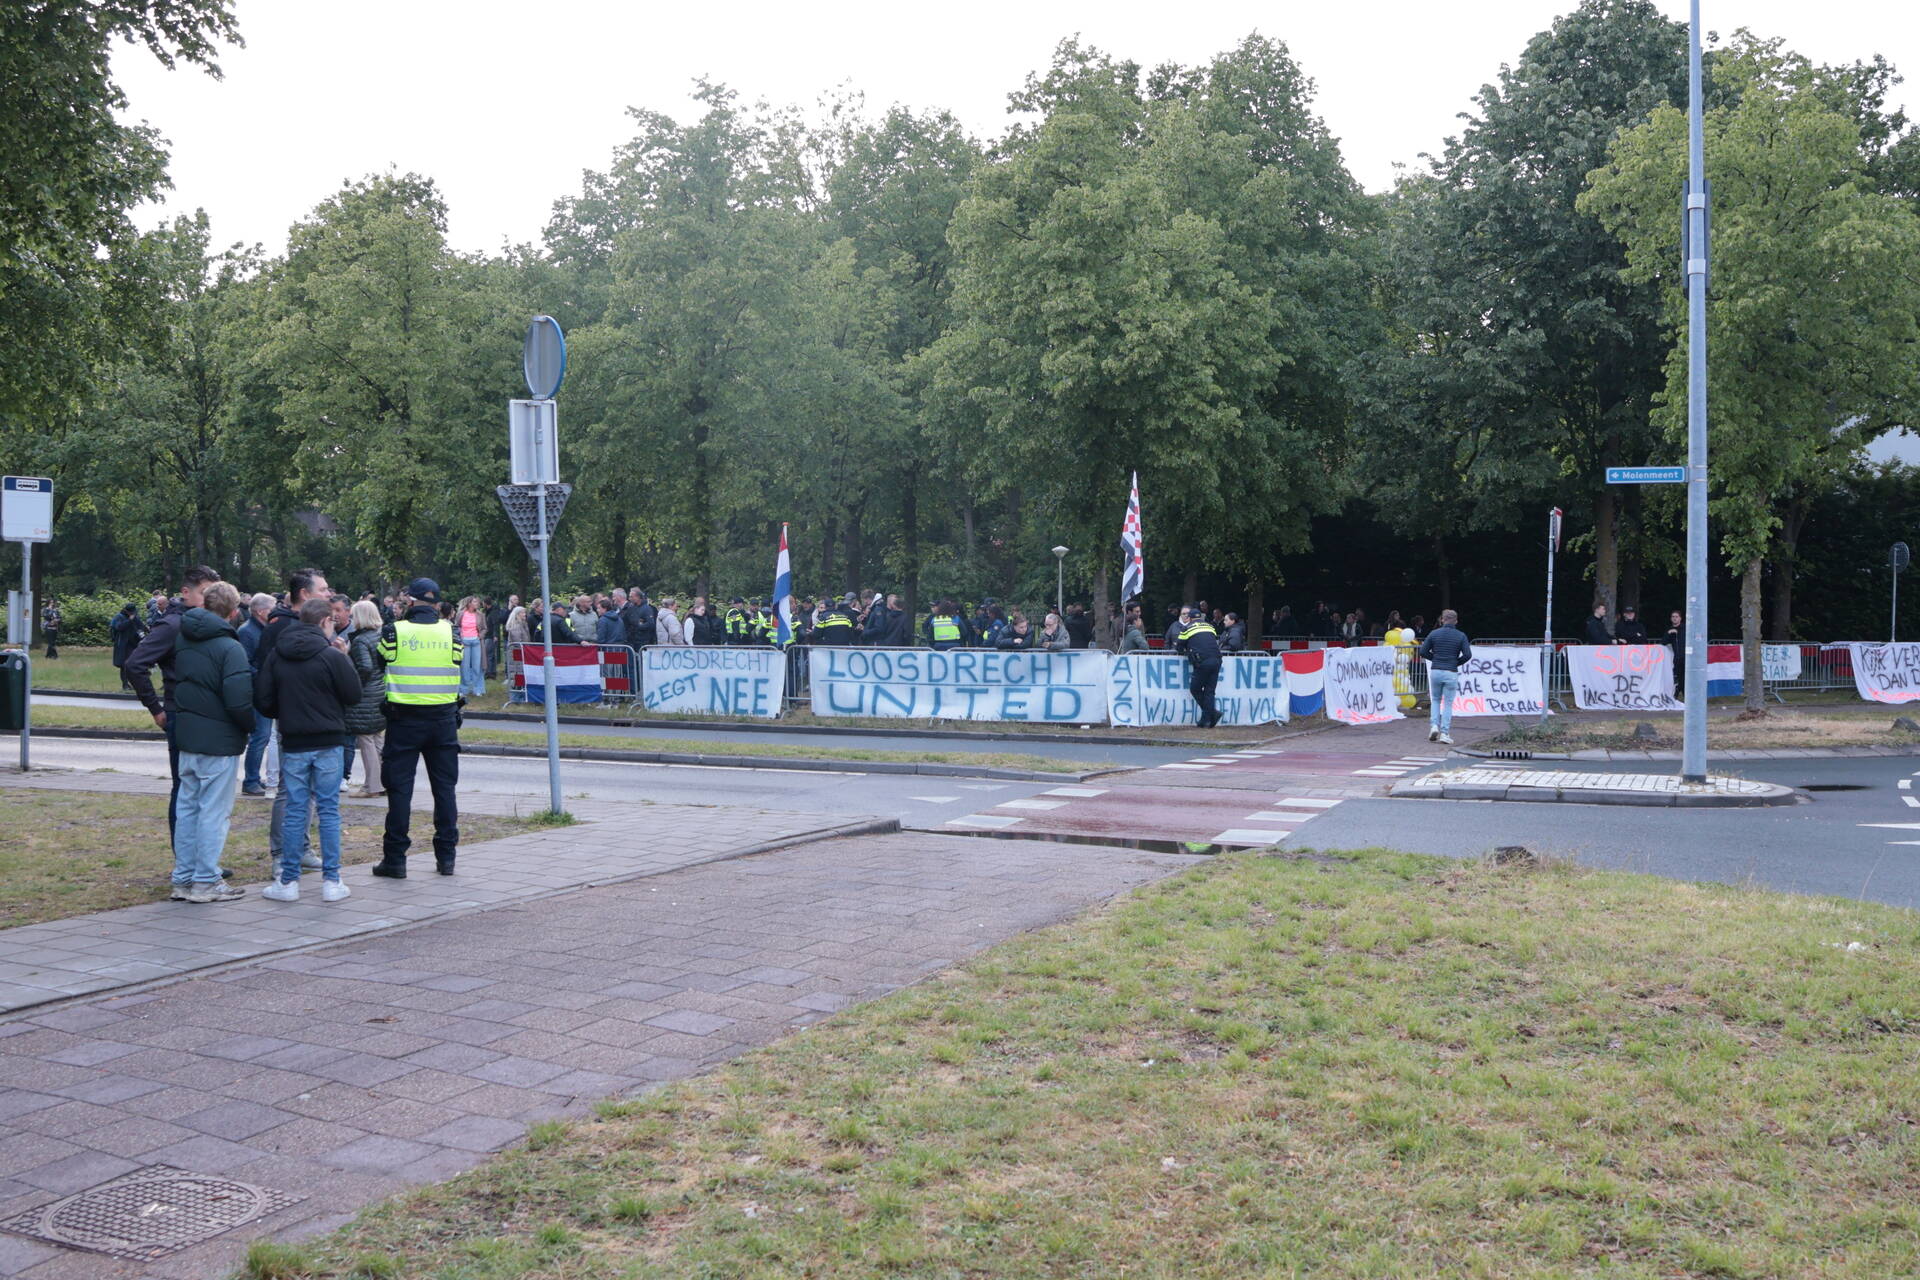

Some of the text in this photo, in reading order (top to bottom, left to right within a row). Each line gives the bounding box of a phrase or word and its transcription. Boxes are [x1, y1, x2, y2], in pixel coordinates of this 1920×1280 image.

[1622, 471, 1679, 479] Molenmeent
[649, 650, 774, 672] LOOSDRECHT
[828, 650, 1081, 683] LOOSDRECHT
[1594, 645, 1665, 674] STOP
[1761, 665, 1788, 679] RIAN
[1877, 672, 1908, 690] DAN
[645, 673, 770, 715] ZEGT NEE
[1612, 674, 1643, 693] DE
[828, 684, 1082, 721] UNITED
